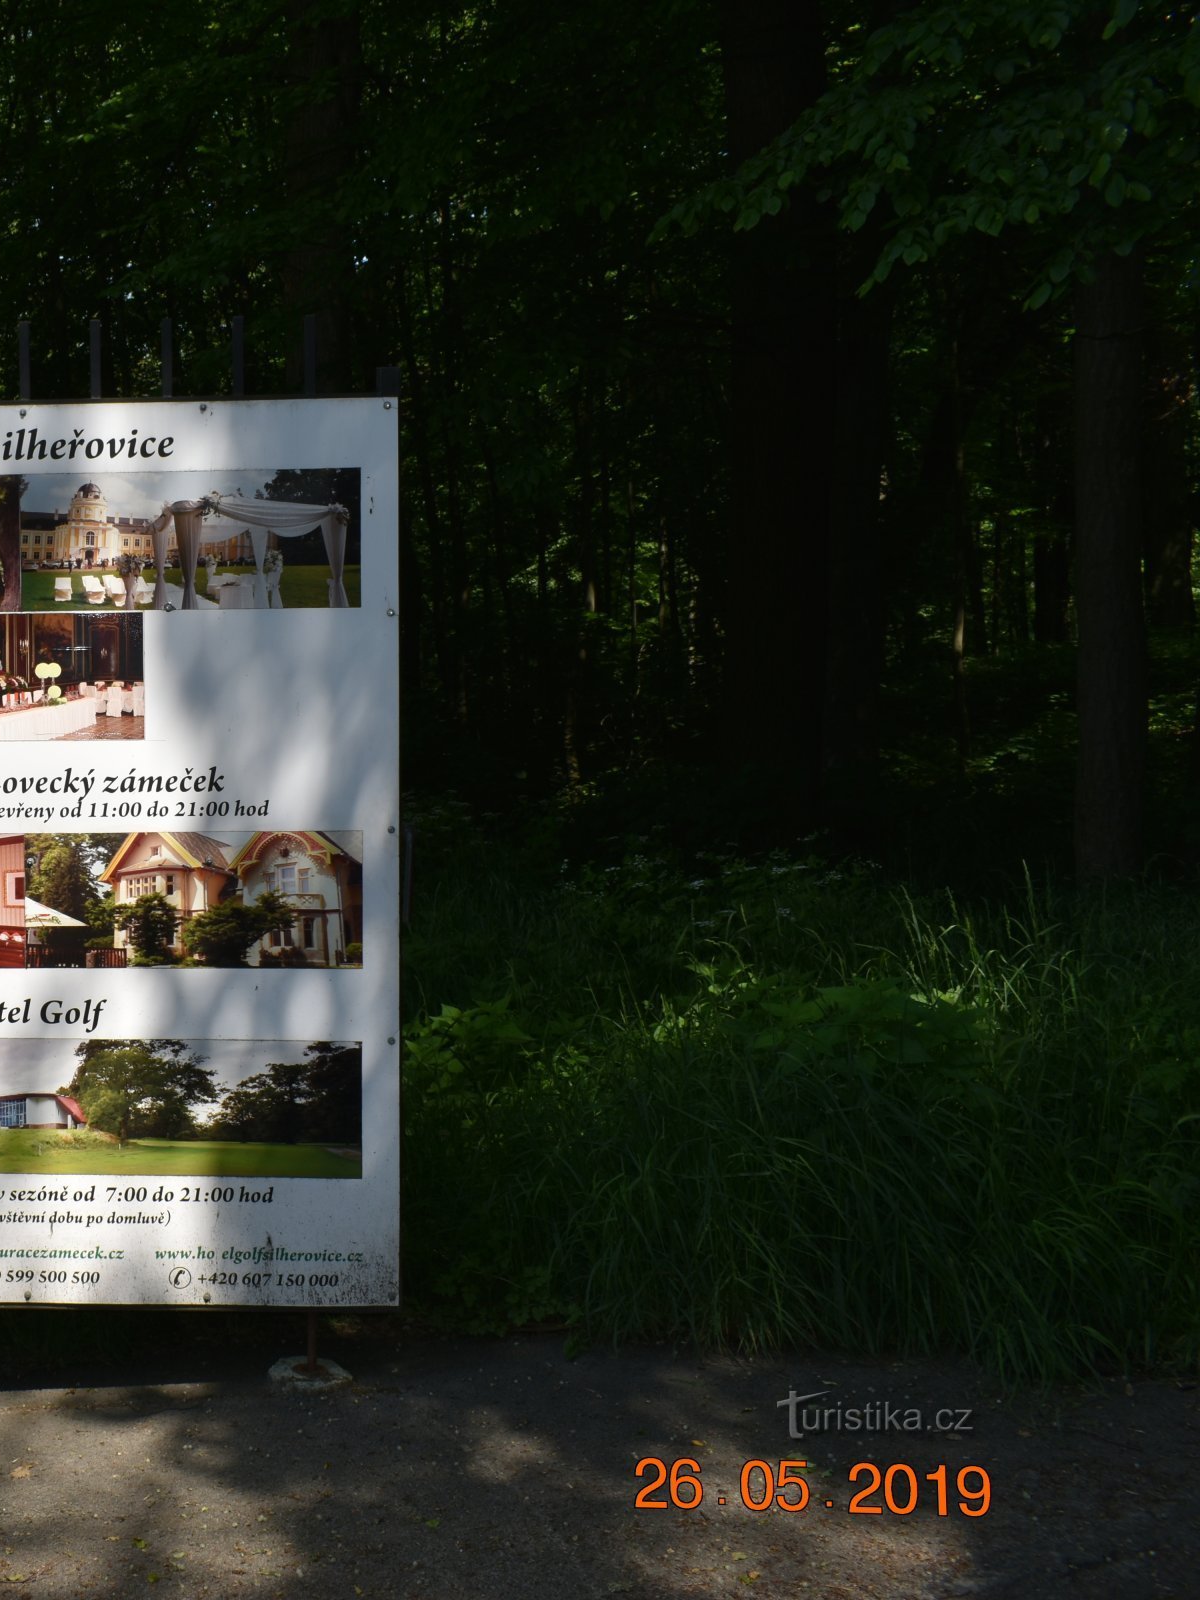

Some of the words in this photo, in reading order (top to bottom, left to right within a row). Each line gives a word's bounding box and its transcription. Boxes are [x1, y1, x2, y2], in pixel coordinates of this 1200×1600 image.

[102, 766, 225, 794] zámeček
[59, 800, 82, 818] od
[88, 801, 142, 818] 11:00
[146, 800, 169, 818] do
[174, 800, 230, 817] 21:00
[234, 799, 270, 817] hod
[40, 998, 108, 1033] Golf
[9, 1185, 69, 1202] sezóně
[73, 1185, 96, 1202] od
[105, 1187, 148, 1202] 7:00
[152, 1185, 175, 1202] do
[179, 1186, 235, 1203] 21:00
[239, 1186, 274, 1203] hod
[49, 1210, 83, 1224] dobu
[86, 1214, 104, 1227] po
[107, 1209, 171, 1227] domluvě)
[155, 1246, 364, 1265] www.hoelgolfsilherovice.cz
[5, 1269, 35, 1283] 599
[38, 1270, 67, 1284] 500
[71, 1270, 100, 1284] 500
[197, 1272, 237, 1287] +420
[241, 1272, 272, 1288] 607
[275, 1273, 305, 1288] 150
[308, 1273, 339, 1288] 000
